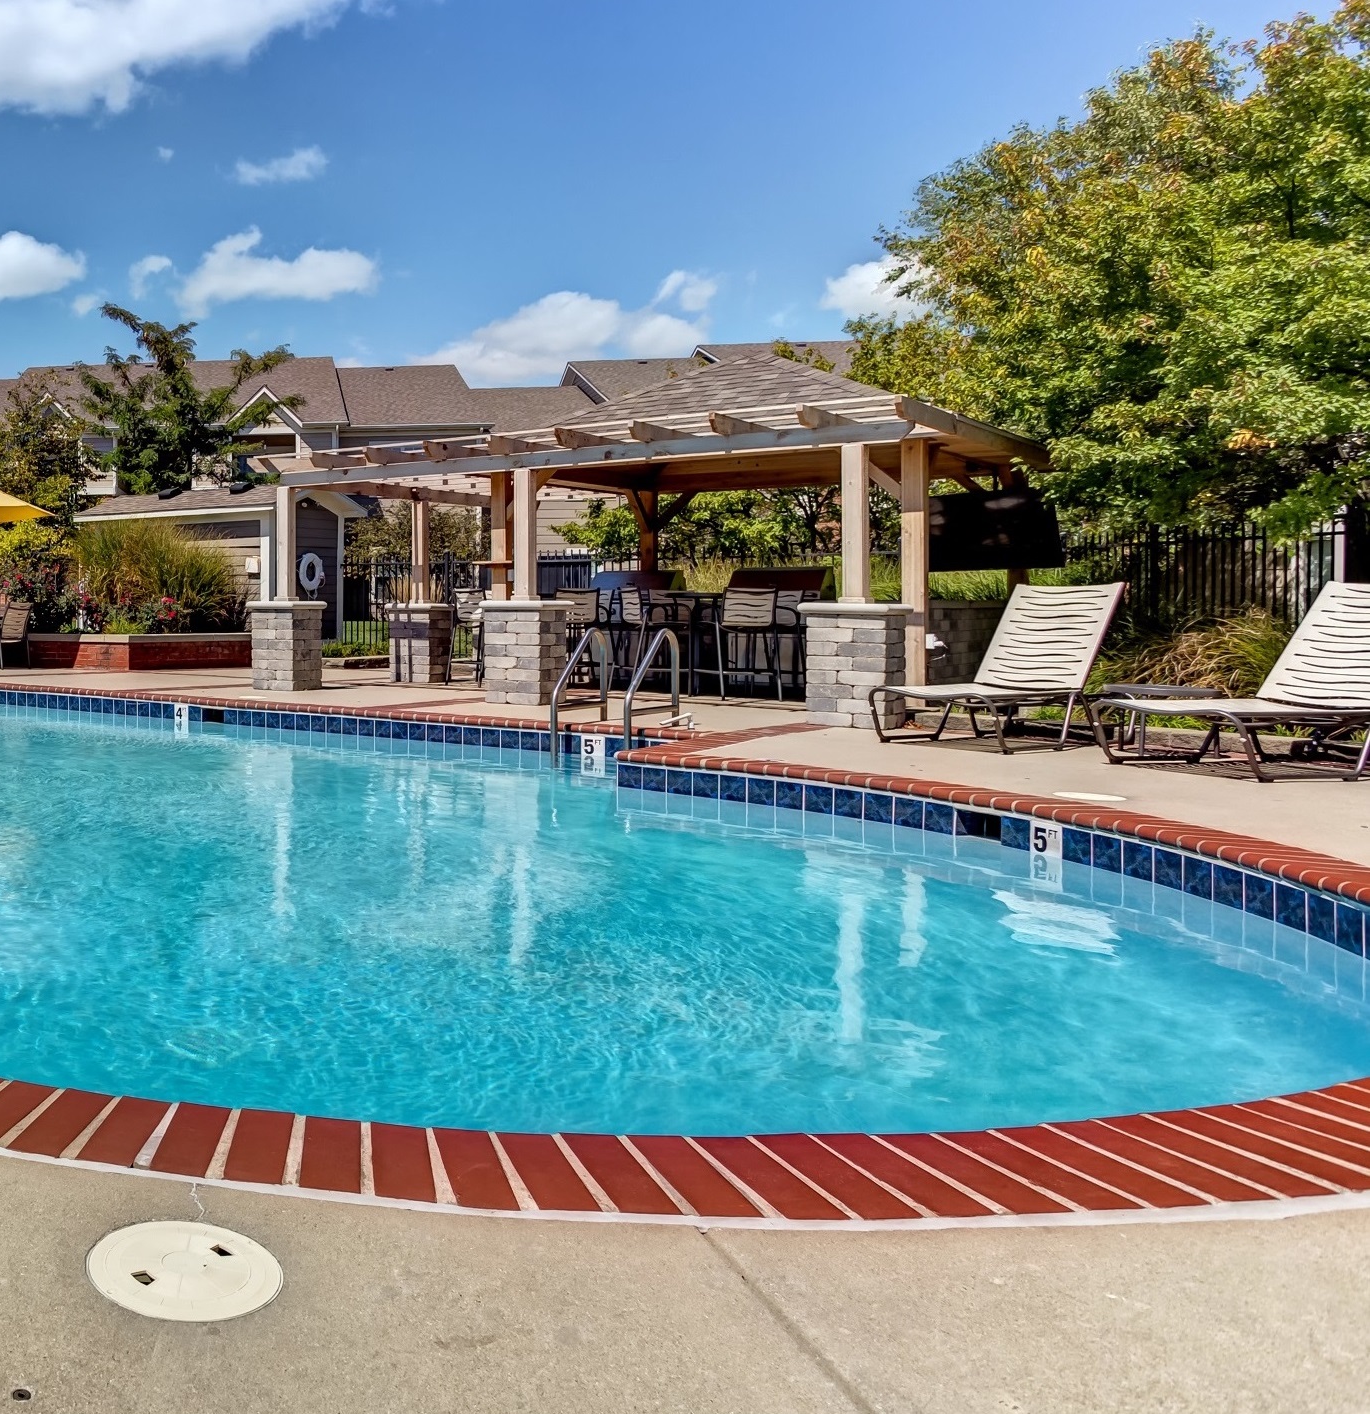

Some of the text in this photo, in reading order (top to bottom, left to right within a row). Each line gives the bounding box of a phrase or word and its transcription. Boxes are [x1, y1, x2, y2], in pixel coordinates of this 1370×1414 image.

[176, 707, 182, 719] 4
[584, 739, 594, 754] 5
[1033, 826, 1058, 852] 5 FT
